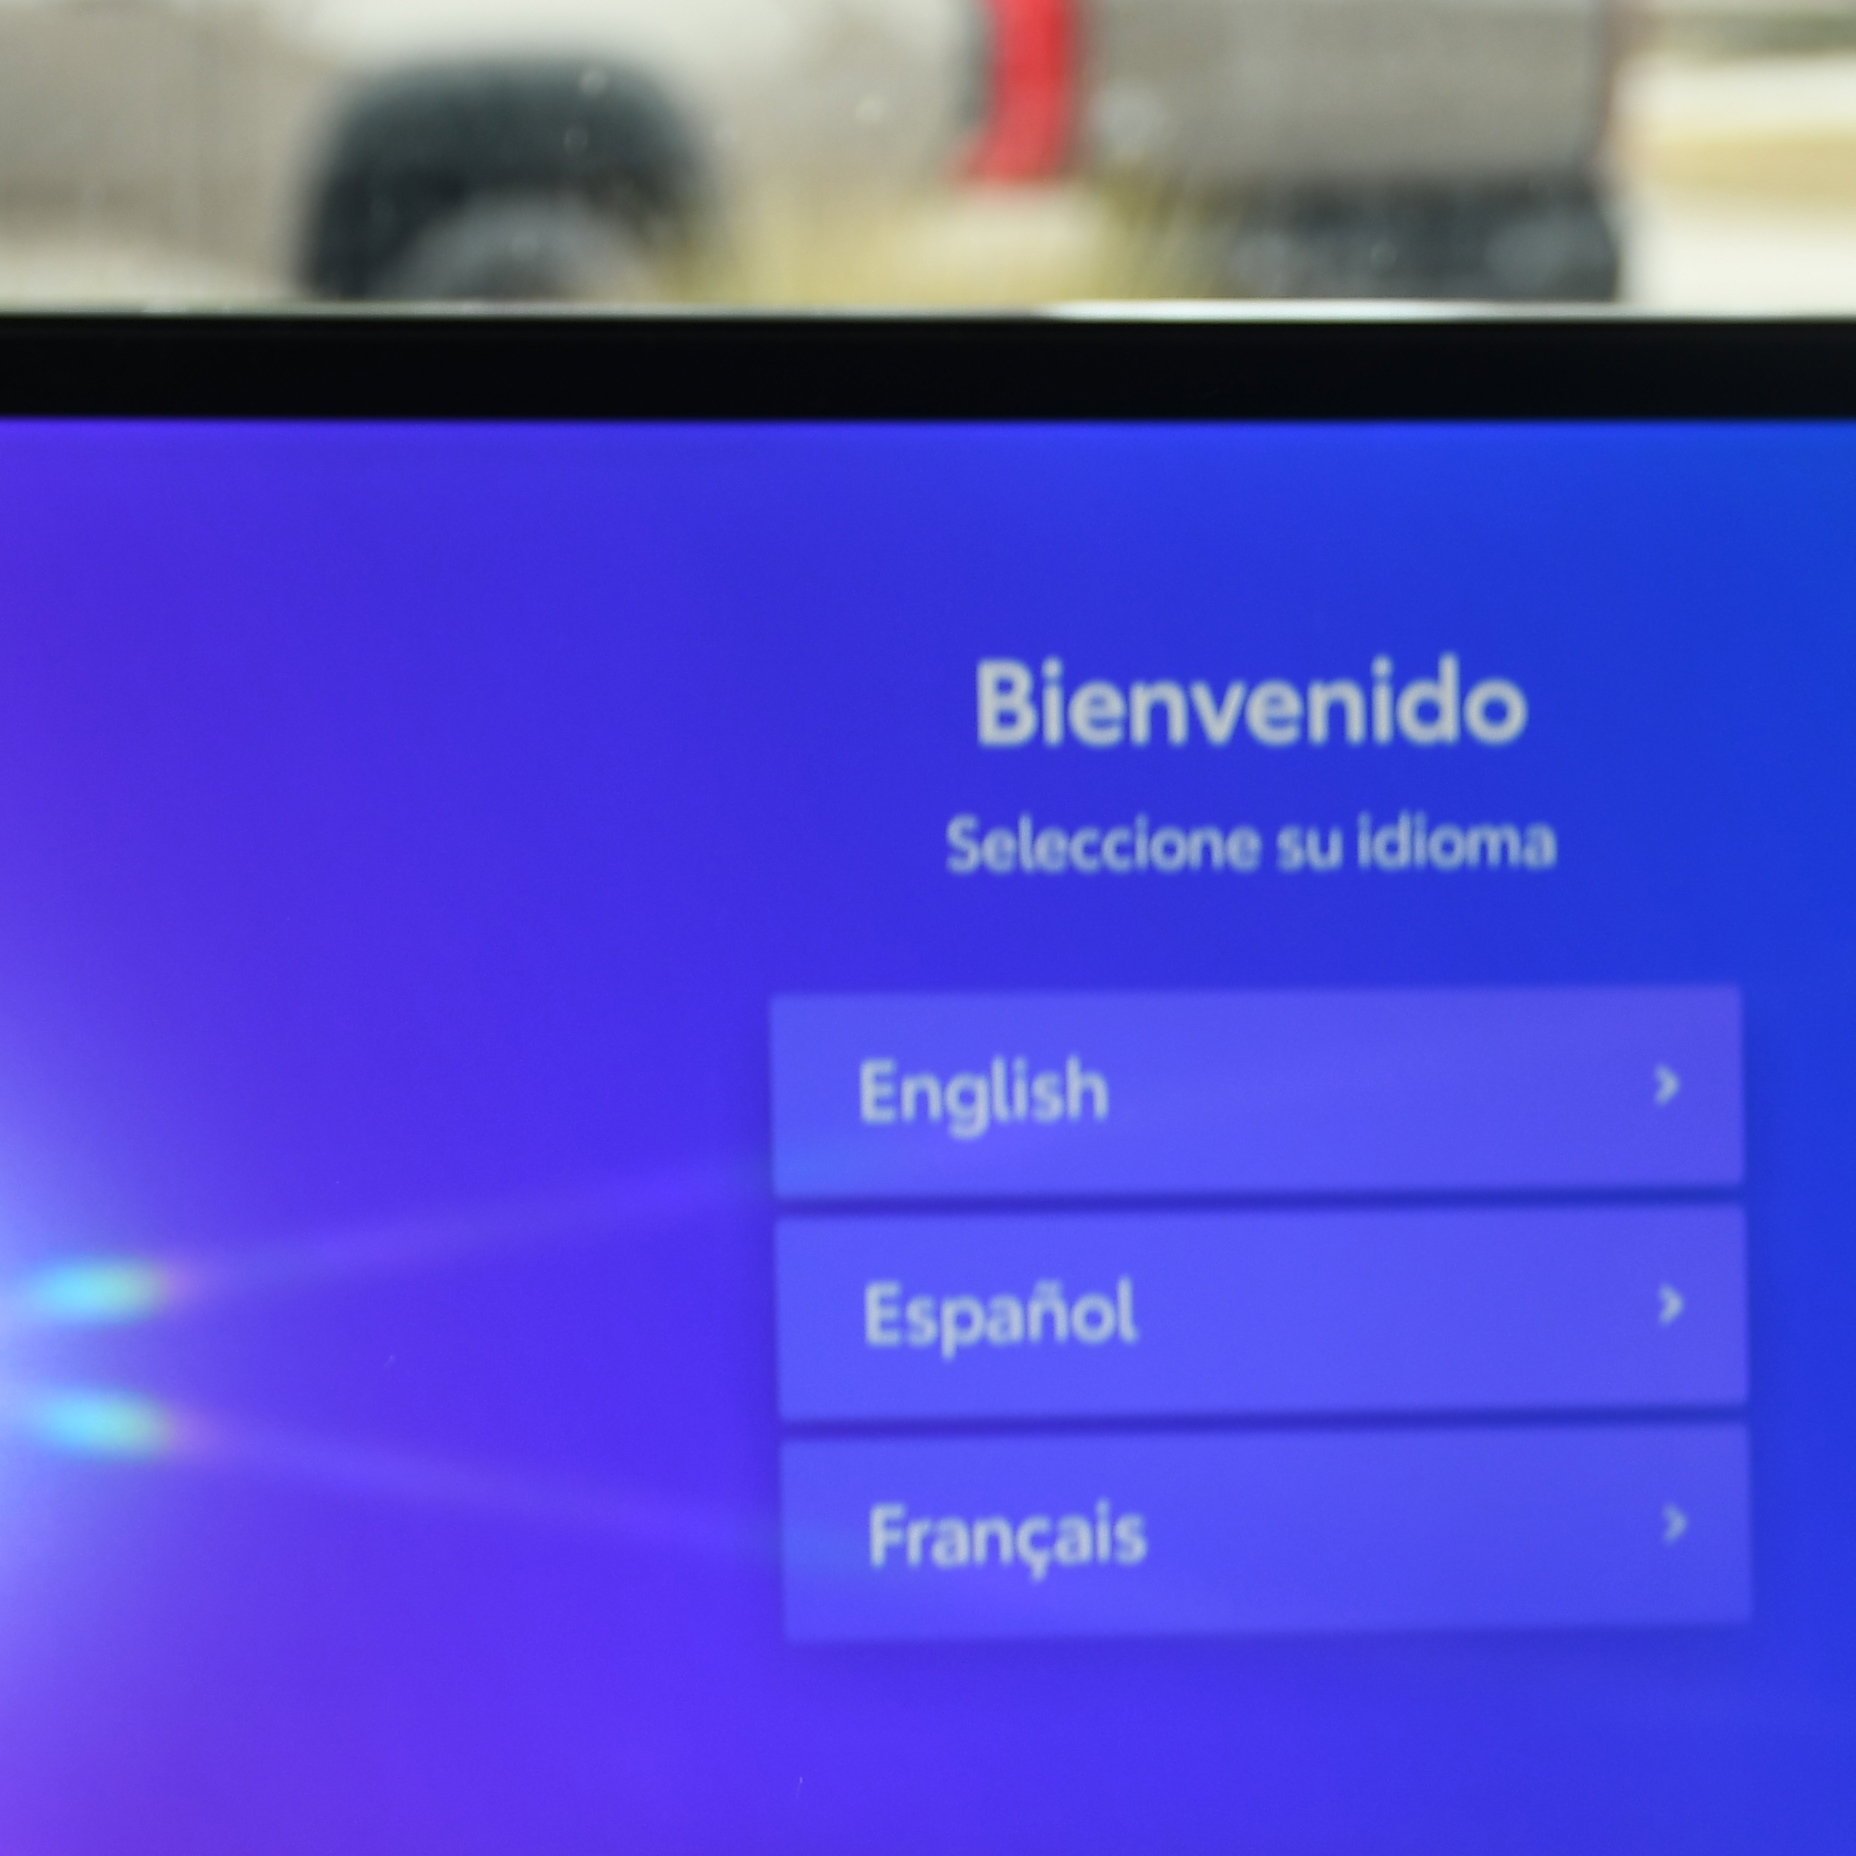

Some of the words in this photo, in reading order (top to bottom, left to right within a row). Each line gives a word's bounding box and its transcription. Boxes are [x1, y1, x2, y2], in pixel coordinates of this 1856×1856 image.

[974, 654, 1530, 748] Bienvenido
[945, 812, 1262, 876] Seleccione
[1275, 824, 1342, 870] su
[1356, 808, 1558, 872] idioma
[857, 1054, 1110, 1140] English
[863, 1276, 1139, 1360] Español
[868, 1498, 1148, 1582] Français
